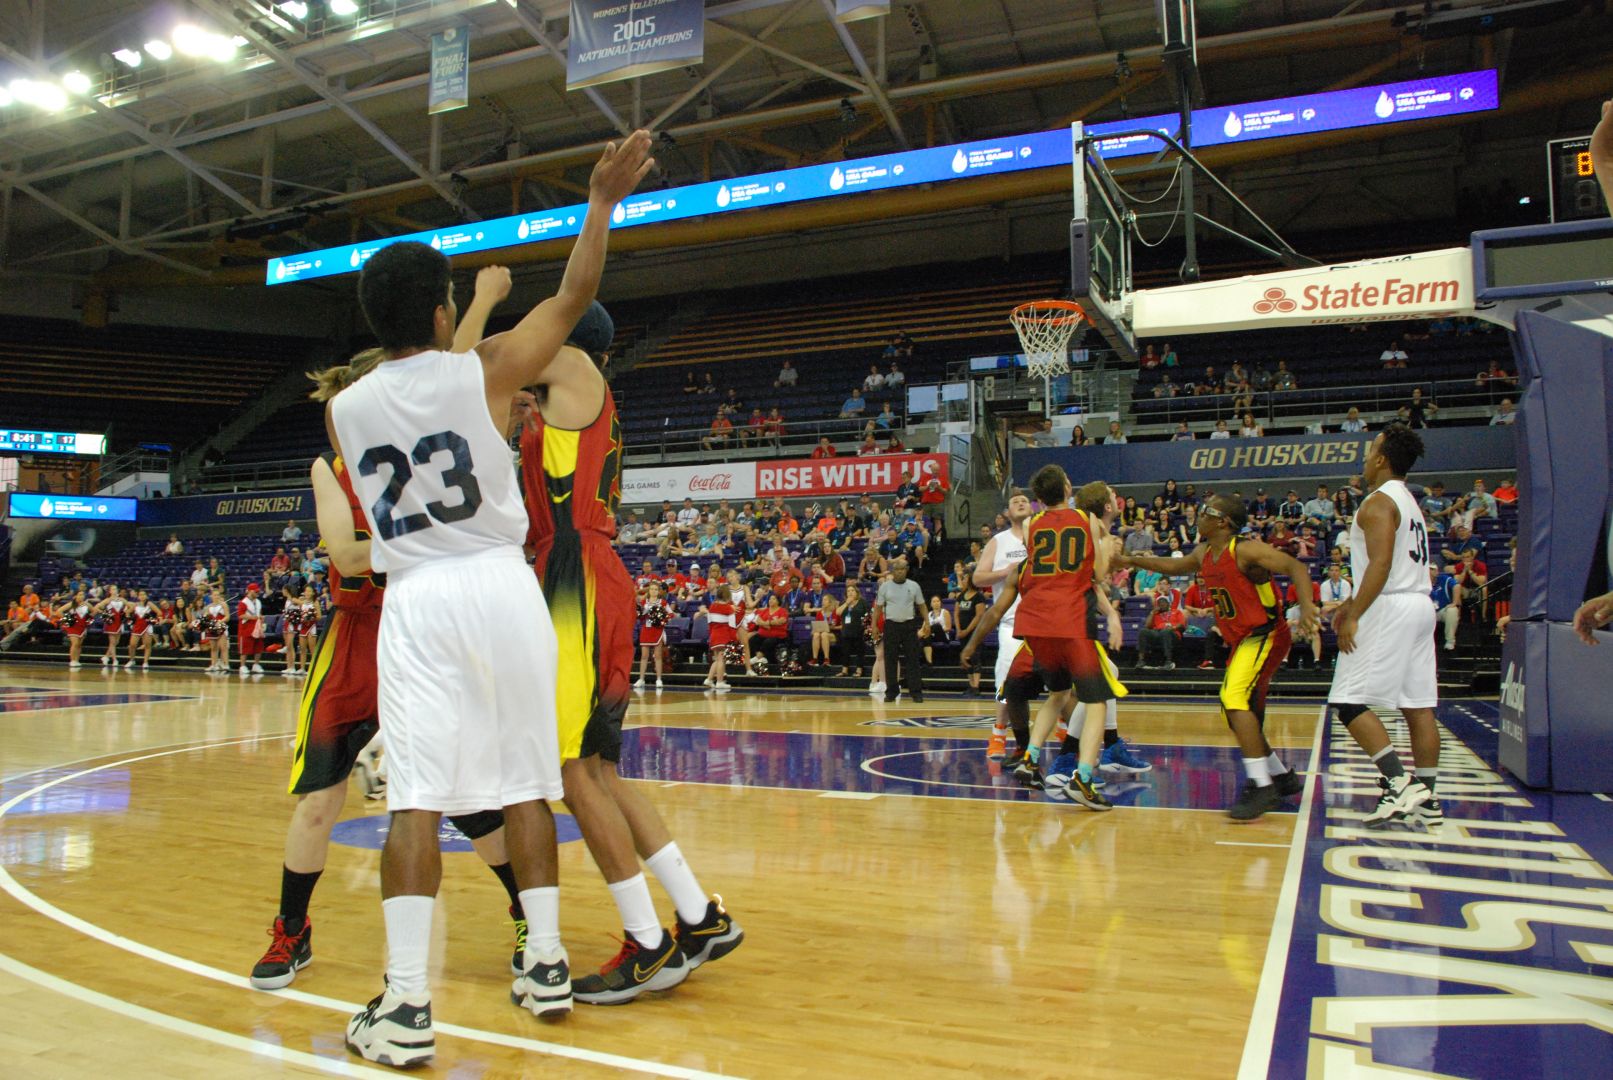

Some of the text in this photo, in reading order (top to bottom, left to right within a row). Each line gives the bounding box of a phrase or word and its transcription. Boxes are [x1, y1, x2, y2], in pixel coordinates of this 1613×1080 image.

[613, 16, 656, 43] 2005
[577, 29, 694, 64] NATIONAL CHAMPIONS
[1190, 440, 1373, 470] GO HUSKIES!
[358, 430, 482, 541] 23
[759, 467, 813, 491] RISE
[820, 462, 891, 488] WITH
[216, 500, 235, 515] GO
[1031, 526, 1087, 576] 20
